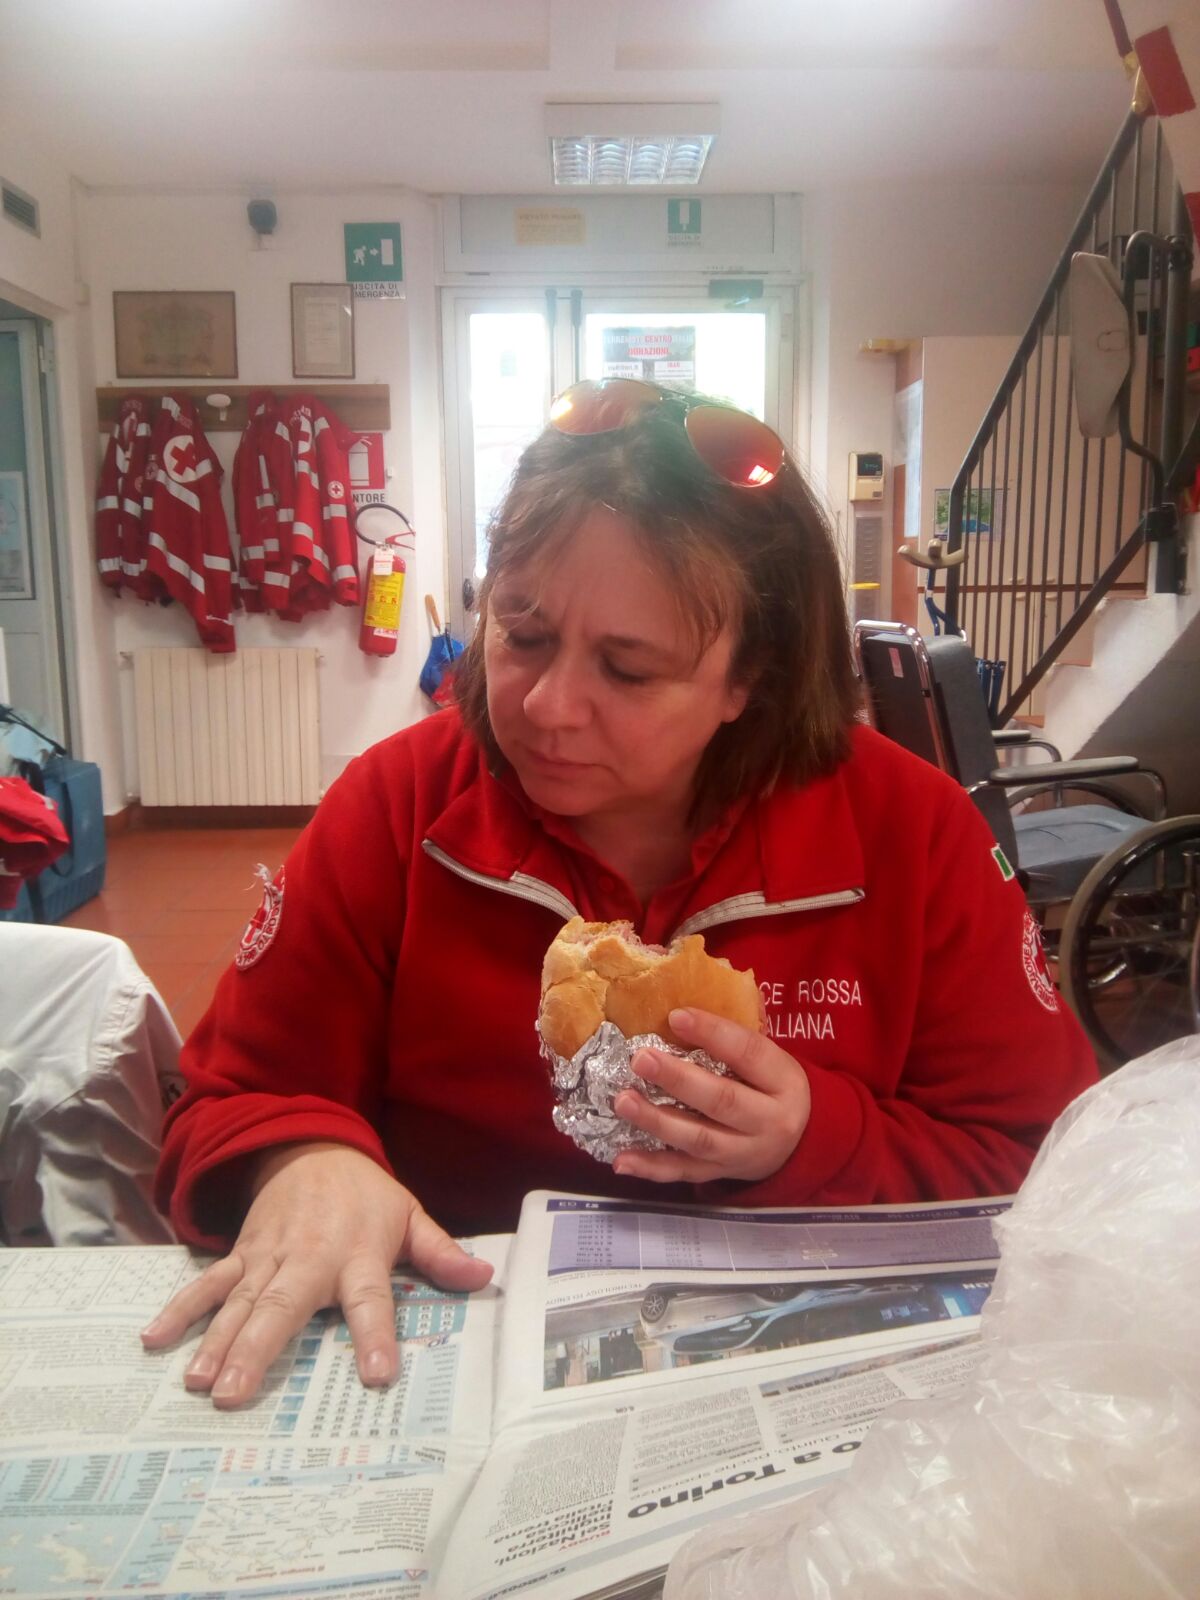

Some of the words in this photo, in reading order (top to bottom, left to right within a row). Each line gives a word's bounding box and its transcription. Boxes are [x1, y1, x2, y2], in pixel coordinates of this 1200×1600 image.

[352, 493, 385, 503] NTORE
[759, 981, 785, 1006] CE
[798, 978, 862, 1006] ROSSA
[793, 1451, 821, 1464] a
[627, 1463, 787, 1518] Torino
[508, 1513, 611, 1553] Inghilterra
[526, 1504, 612, 1539] bellicosa
[580, 1521, 610, 1537] Sei
[494, 1533, 576, 1566] Nazioni,
